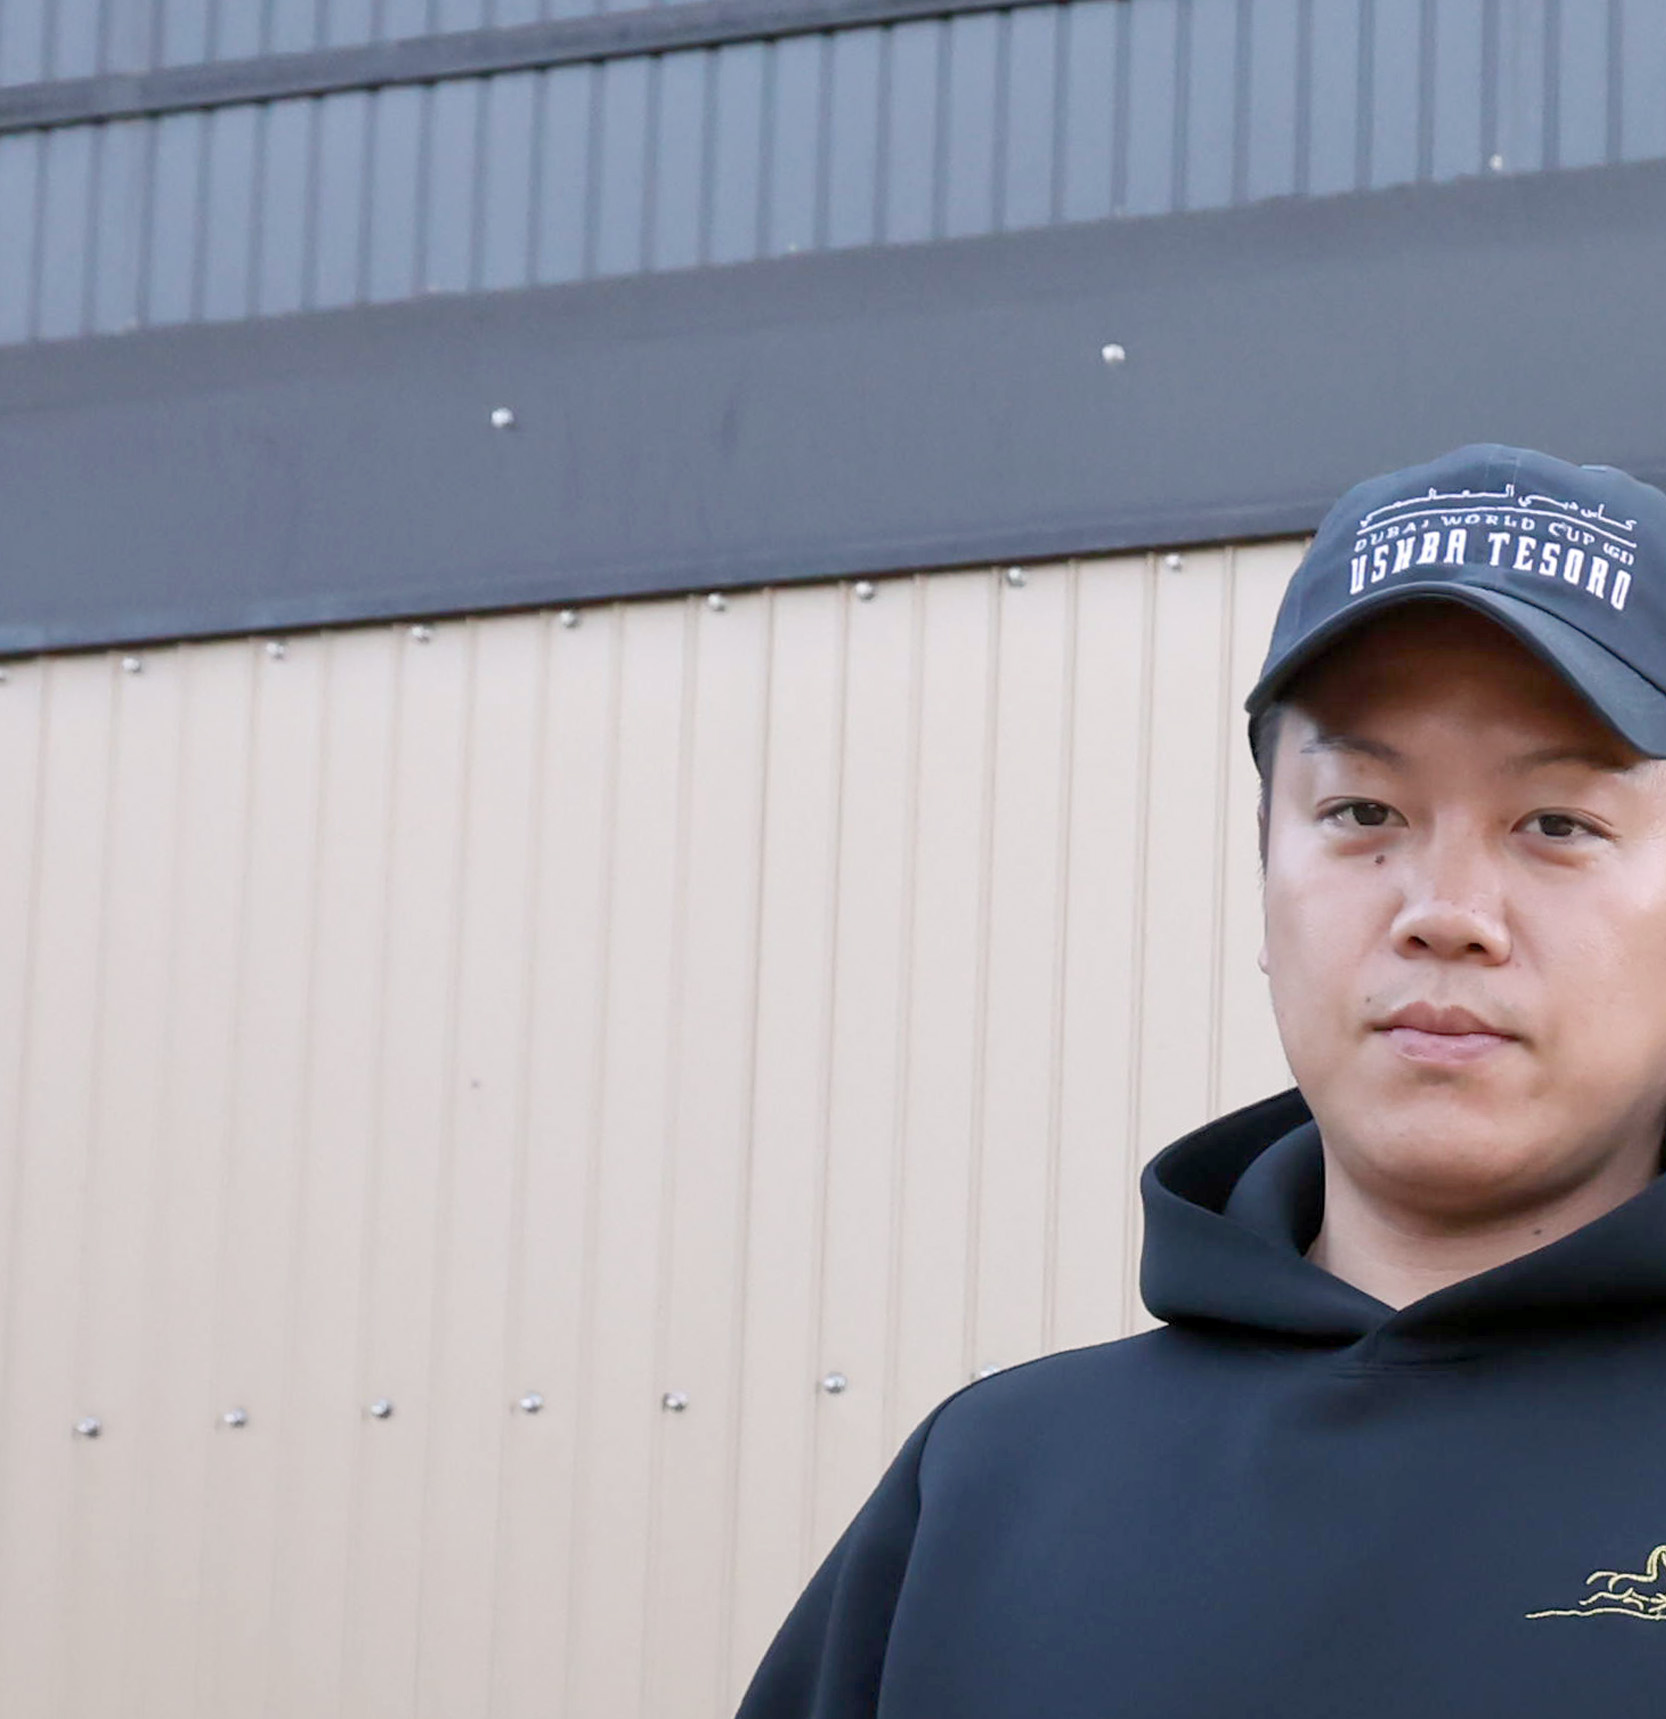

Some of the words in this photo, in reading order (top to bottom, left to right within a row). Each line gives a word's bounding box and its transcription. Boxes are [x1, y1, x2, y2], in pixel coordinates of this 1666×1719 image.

[1353, 519, 1430, 553] DUBAI
[1440, 513, 1536, 532] WORLD
[1547, 521, 1596, 546] CUP
[1349, 528, 1467, 596] USHBA
[1487, 531, 1632, 612] TESORO
